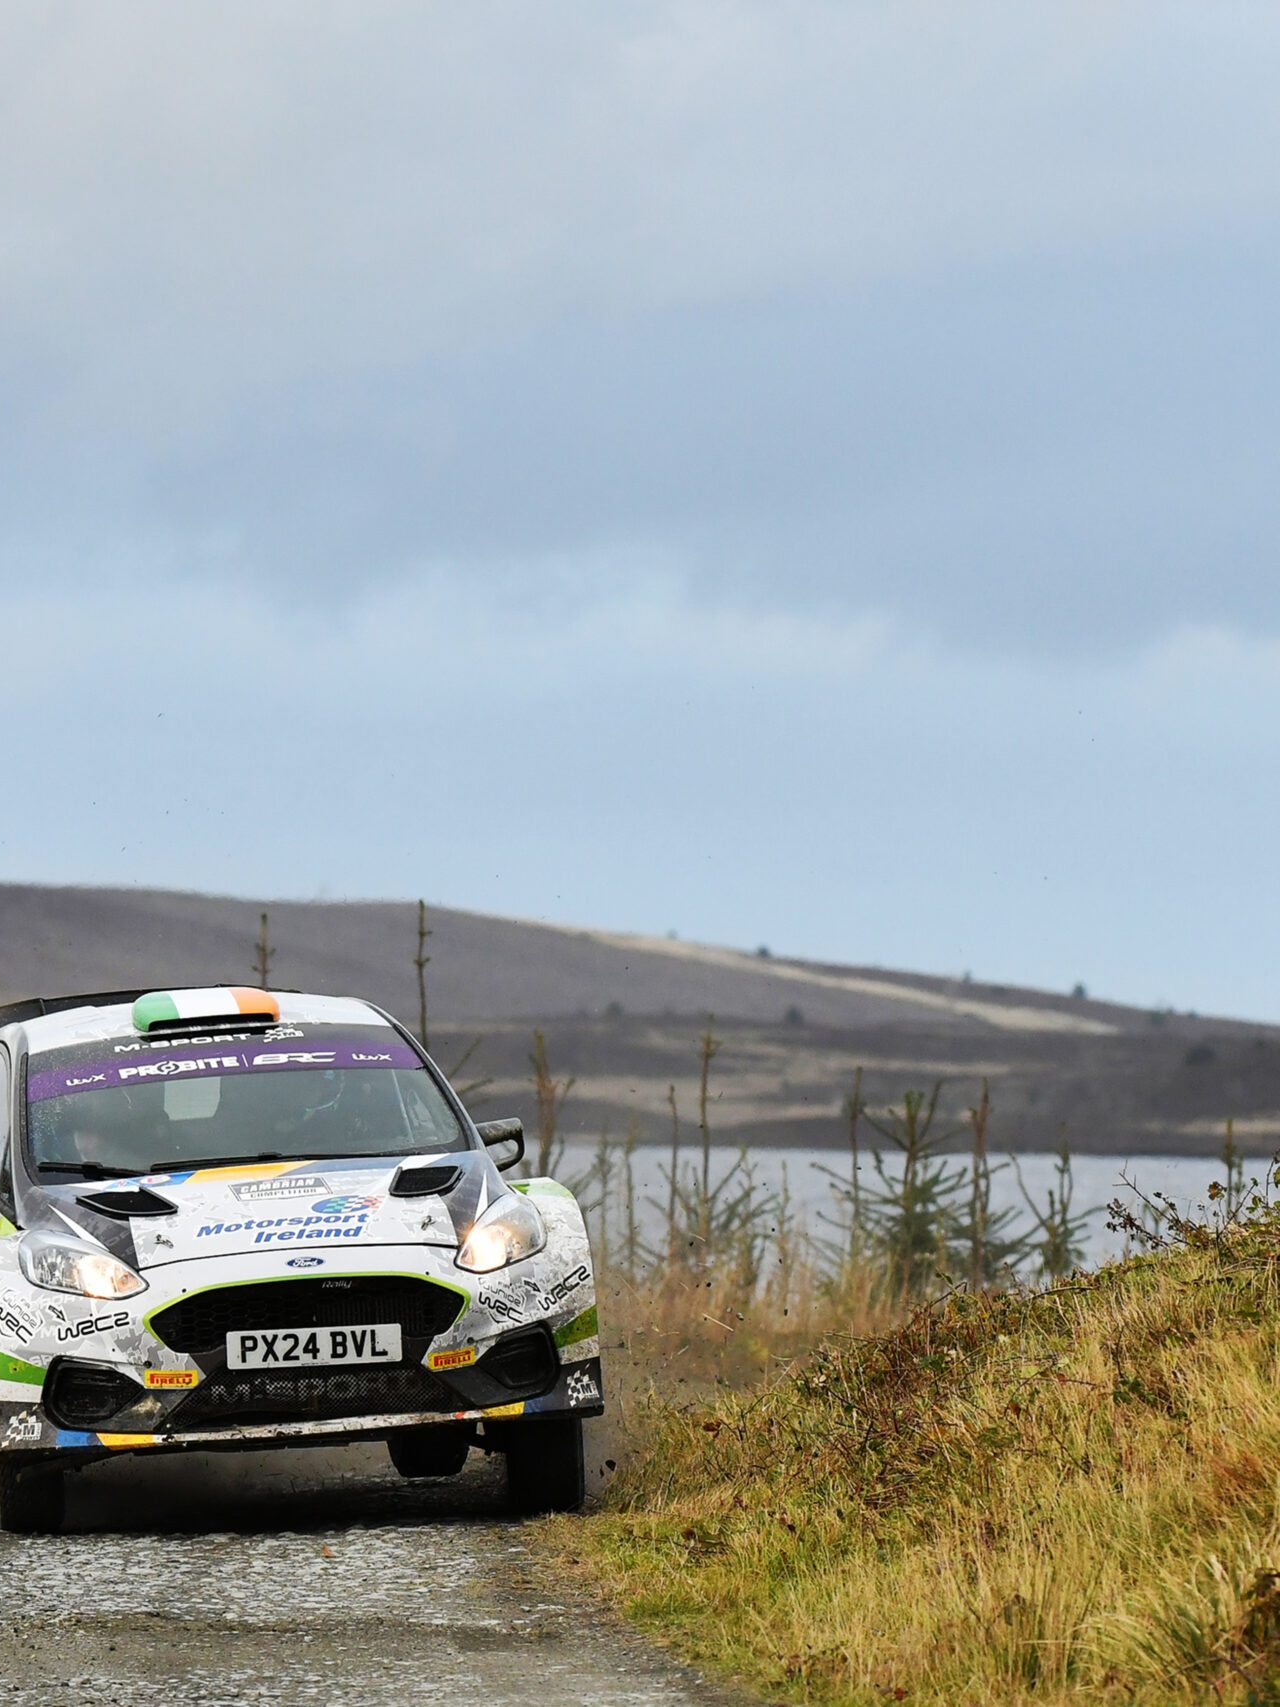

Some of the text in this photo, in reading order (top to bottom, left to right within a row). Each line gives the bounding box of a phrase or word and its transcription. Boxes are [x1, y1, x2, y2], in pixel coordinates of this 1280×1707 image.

[118, 1056, 240, 1079] PROBITE
[253, 1051, 337, 1066] BRC
[240, 1178, 316, 1193] CAMBRIAN
[197, 1212, 370, 1238] Motorsport
[254, 1225, 363, 1244] Ireland
[537, 1265, 591, 1311] WRC2
[479, 1291, 524, 1324] WRC
[58, 1312, 130, 1342] WRC2
[240, 1329, 389, 1364] PX24 BVL
[434, 1350, 471, 1367] PIRELLI
[150, 1373, 193, 1385] PIRELLI
